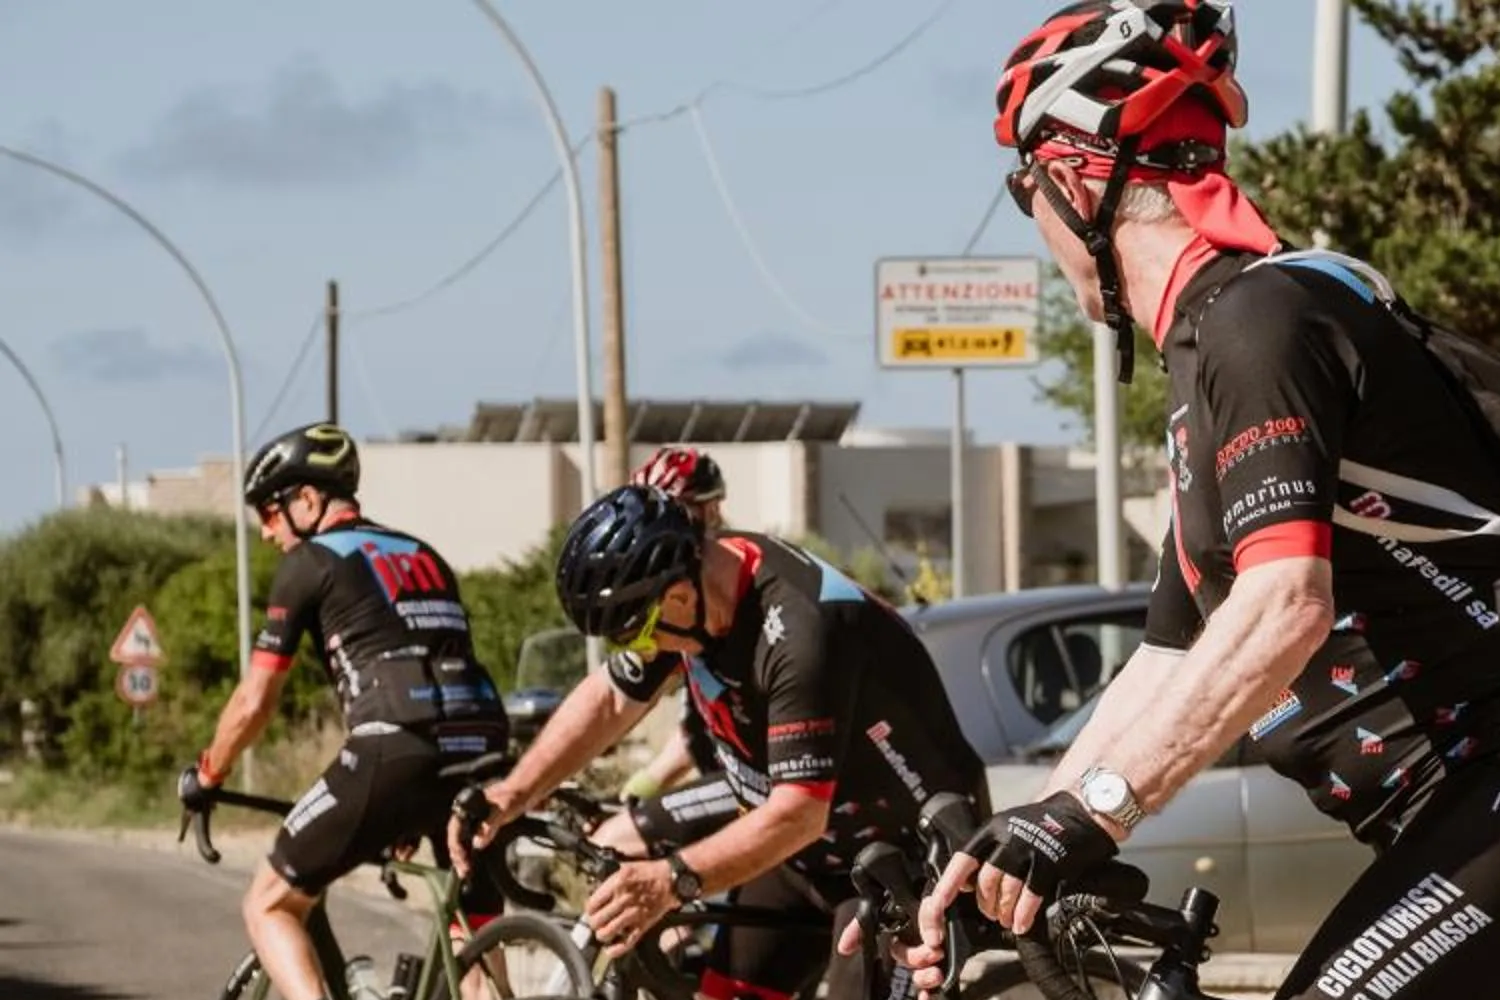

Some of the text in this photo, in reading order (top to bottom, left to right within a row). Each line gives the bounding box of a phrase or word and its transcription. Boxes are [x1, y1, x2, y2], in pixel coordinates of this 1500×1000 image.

[883, 283, 1037, 300] ATTENZIONE
[1465, 600, 1499, 630] sa
[1317, 872, 1464, 999] CICLOTURISTI
[1365, 951, 1424, 1000] VALLI
[1410, 904, 1493, 965] BIASCA
